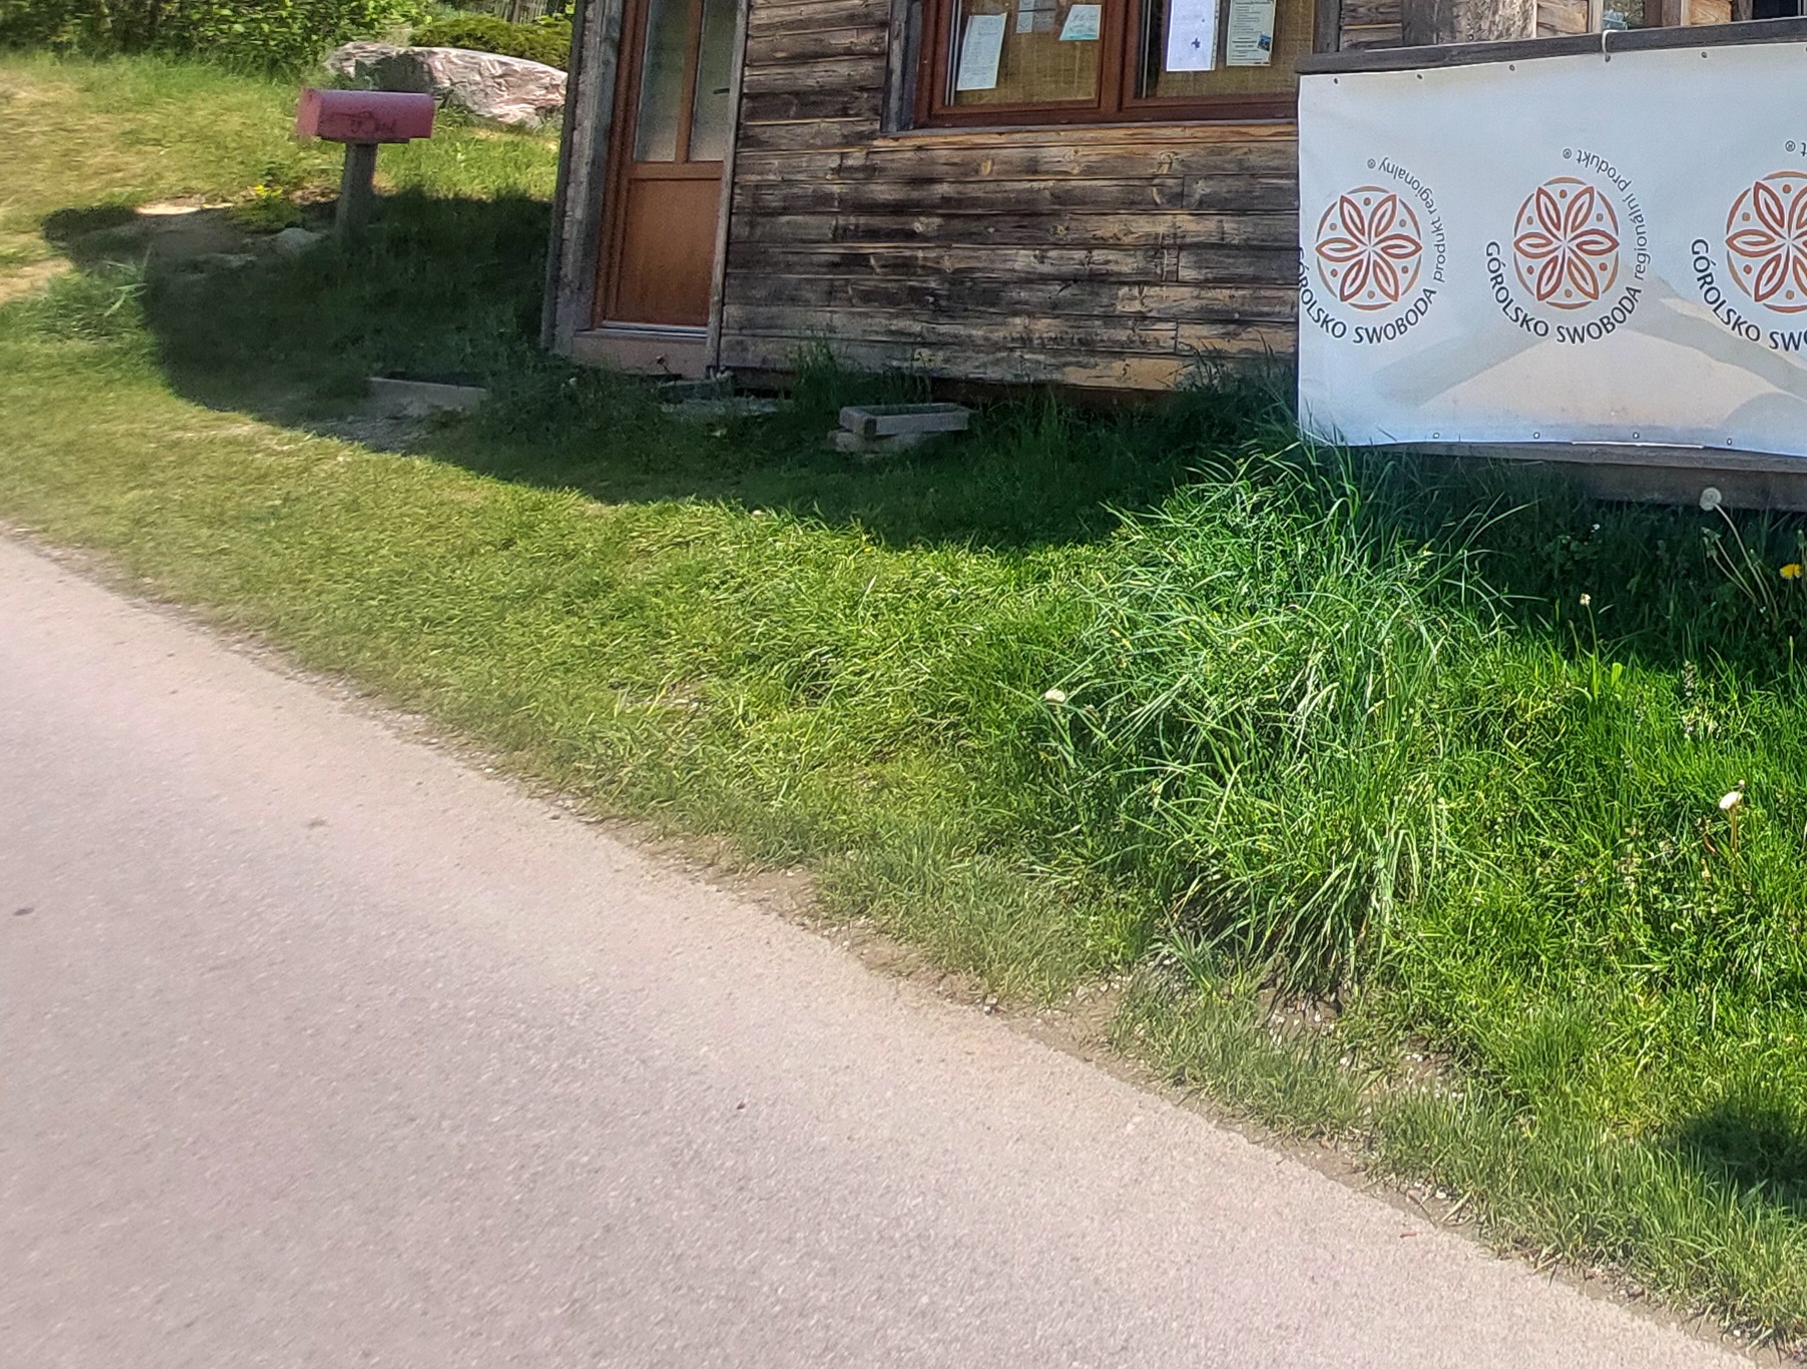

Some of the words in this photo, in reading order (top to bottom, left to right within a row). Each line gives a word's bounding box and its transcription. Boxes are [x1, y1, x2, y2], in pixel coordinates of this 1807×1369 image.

[1378, 157, 1437, 215] regionalny
[1576, 149, 1632, 192] produkt
[1431, 217, 1446, 283] produkt
[1622, 193, 1651, 280] regionální
[1353, 287, 1437, 344] SWOBODA
[1486, 241, 1549, 337] GÓROLSKO
[1557, 286, 1642, 344] SWOBODA
[1691, 239, 1761, 342] GÓROLSKO
